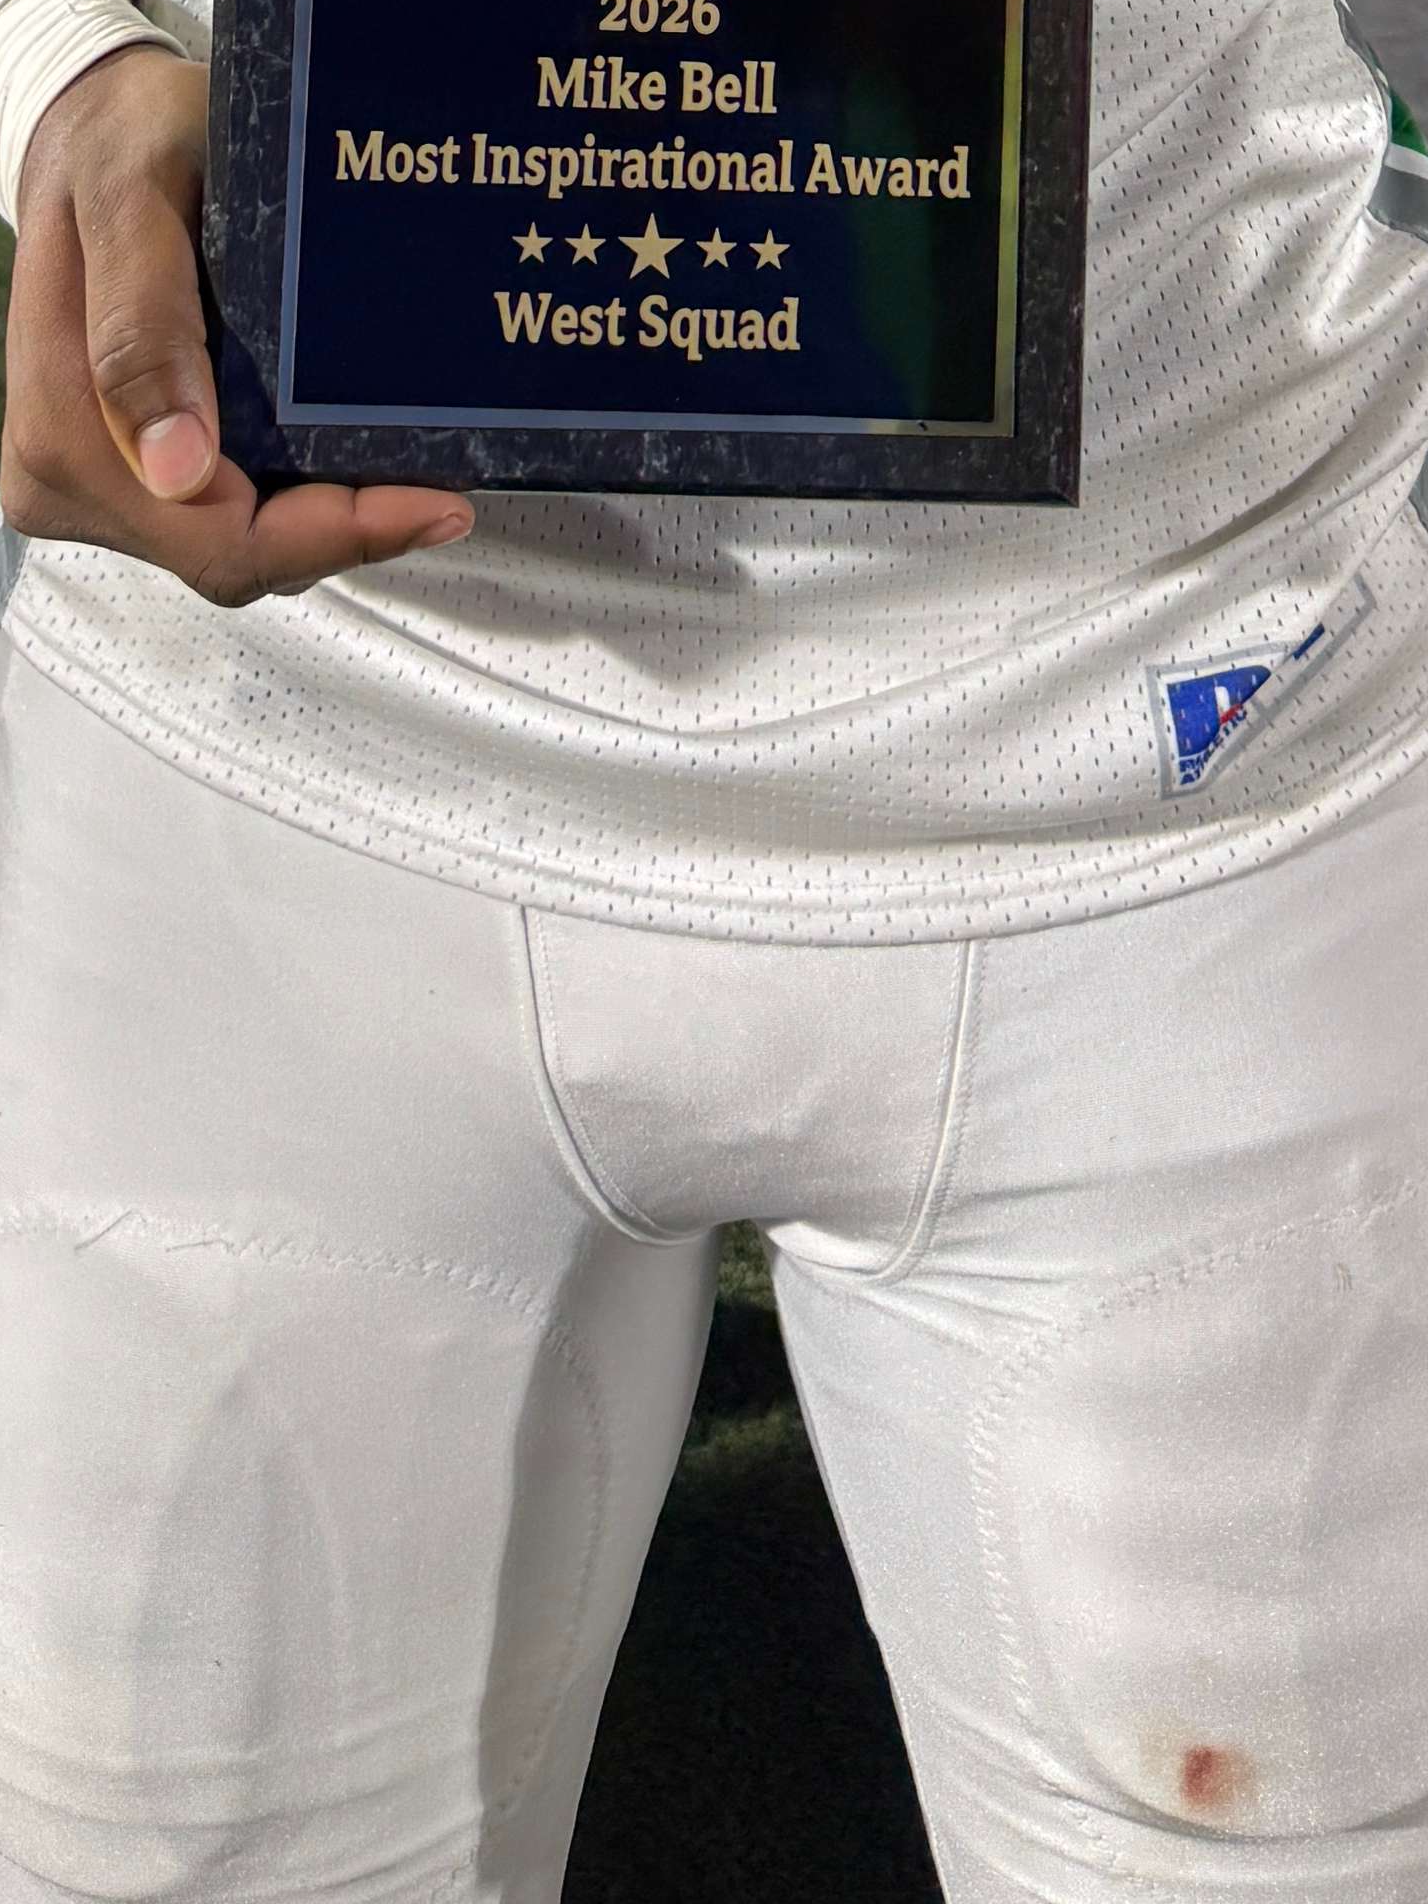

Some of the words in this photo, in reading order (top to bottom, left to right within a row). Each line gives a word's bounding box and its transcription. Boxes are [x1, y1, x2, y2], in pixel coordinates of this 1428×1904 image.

[536, 55, 667, 111] Mike
[679, 60, 778, 114] Bell
[335, 130, 461, 184] Most
[472, 133, 795, 199] Inspirational
[804, 143, 971, 199] Award
[493, 291, 627, 347] West
[638, 294, 801, 362] Squad
